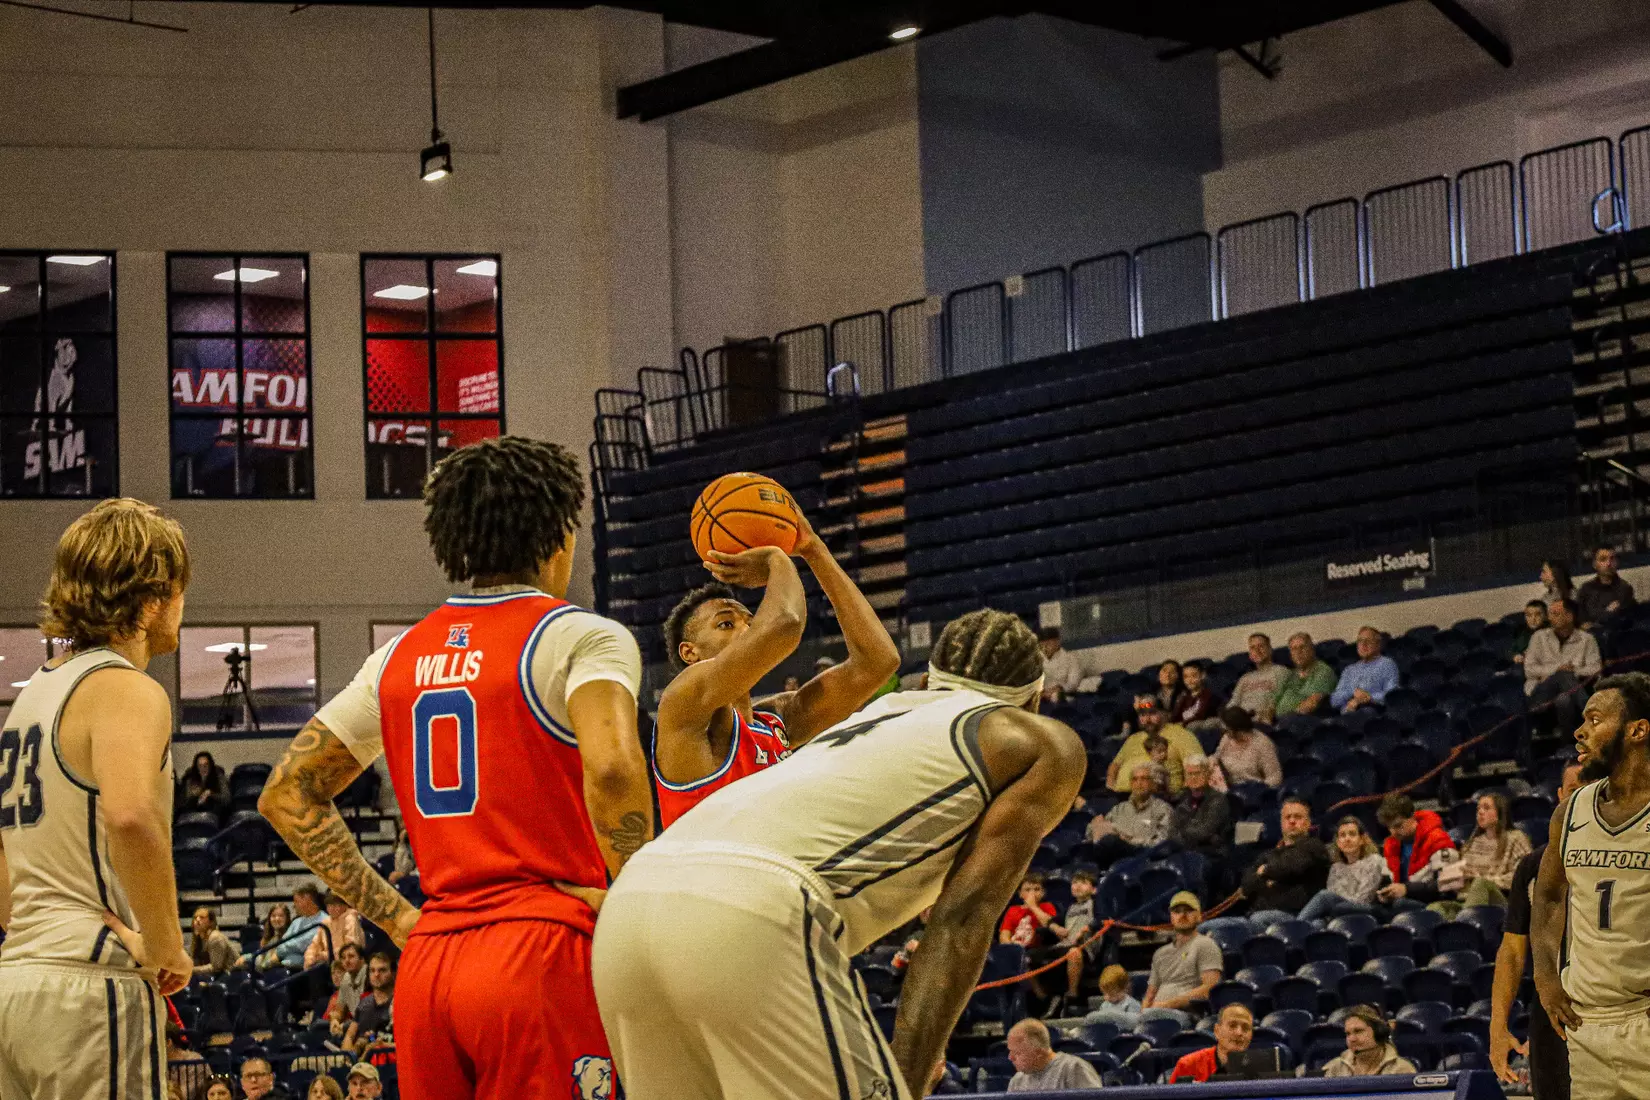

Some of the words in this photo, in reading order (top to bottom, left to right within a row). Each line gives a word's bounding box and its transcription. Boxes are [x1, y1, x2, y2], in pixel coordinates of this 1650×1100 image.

[1327, 555, 1383, 580] Reserved
[1384, 550, 1430, 571] Seating
[415, 650, 483, 687] WILLIS
[412, 686, 479, 818] 0
[0, 722, 45, 829] 23
[1565, 849, 1650, 870] SAMFOR
[1595, 879, 1617, 930] 1
